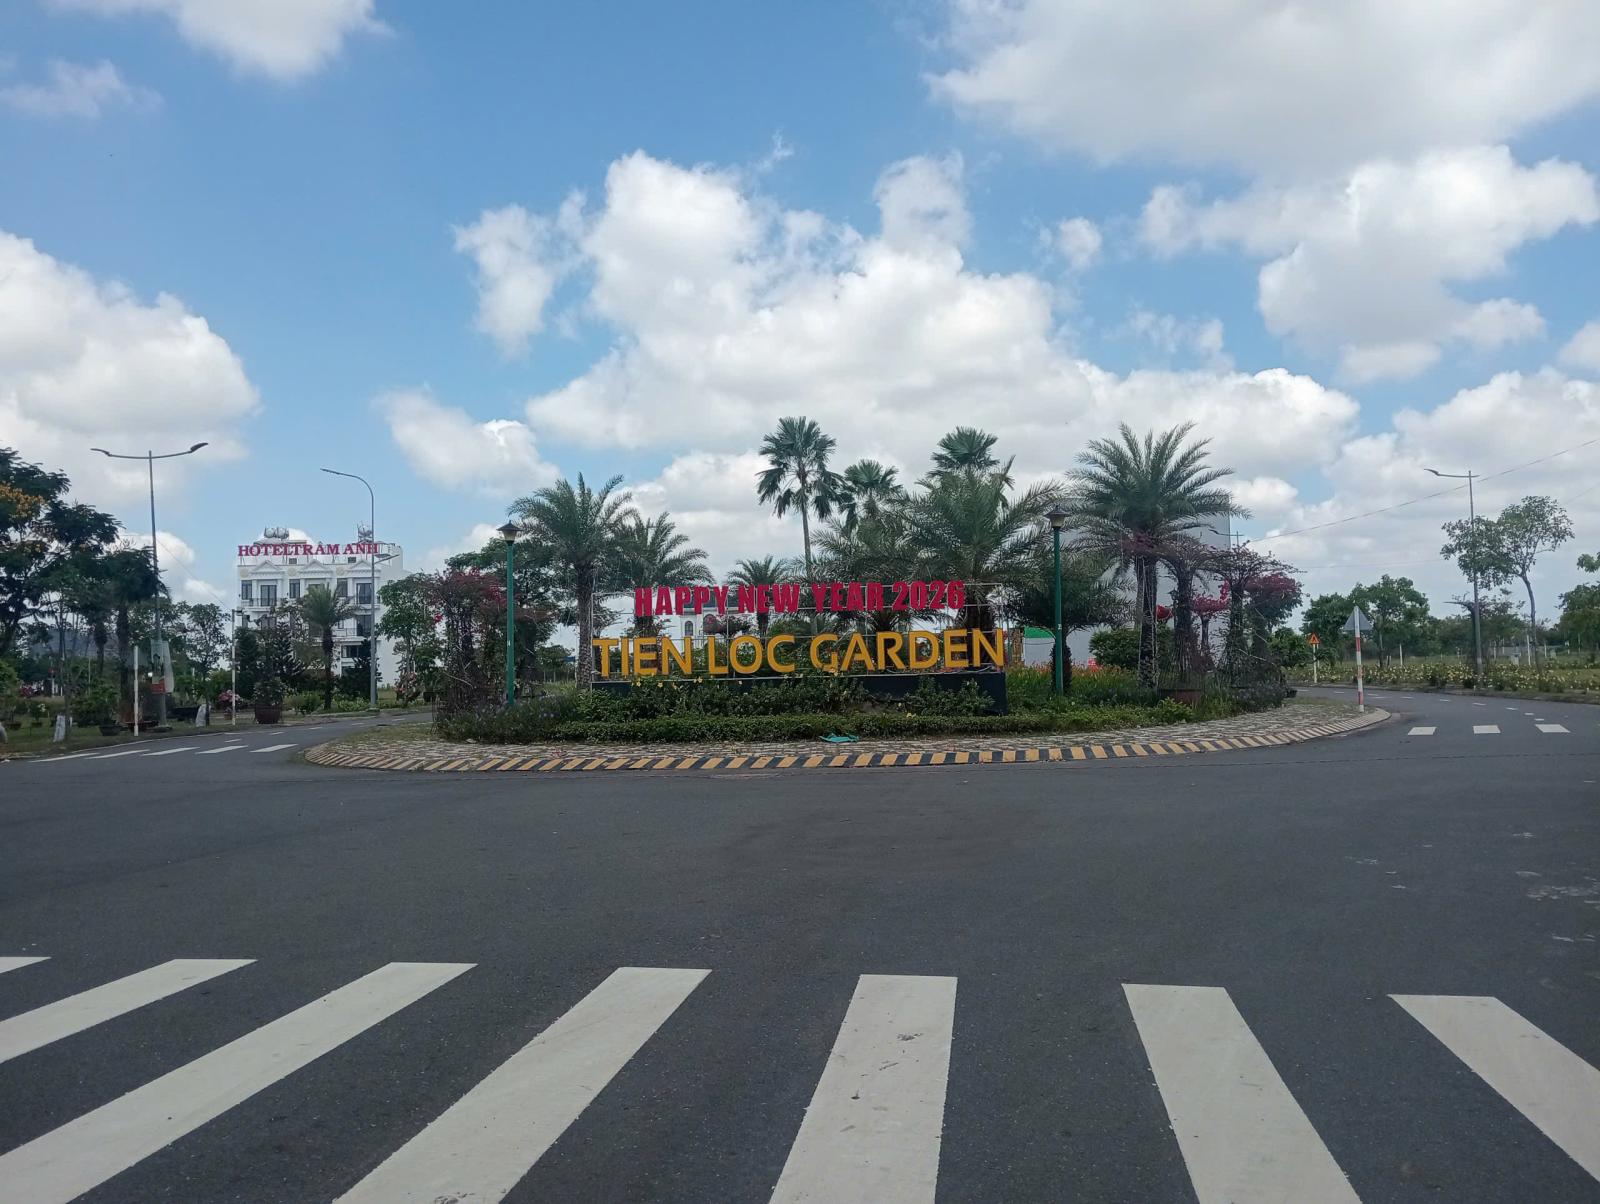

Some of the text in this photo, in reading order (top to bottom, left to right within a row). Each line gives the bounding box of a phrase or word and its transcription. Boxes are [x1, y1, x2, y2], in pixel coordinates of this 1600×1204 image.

[342, 543, 379, 555] ANH
[634, 579, 966, 617] HAPPY NEW YEAR 2026
[591, 627, 1005, 677] TIEN LOC GARDEN
